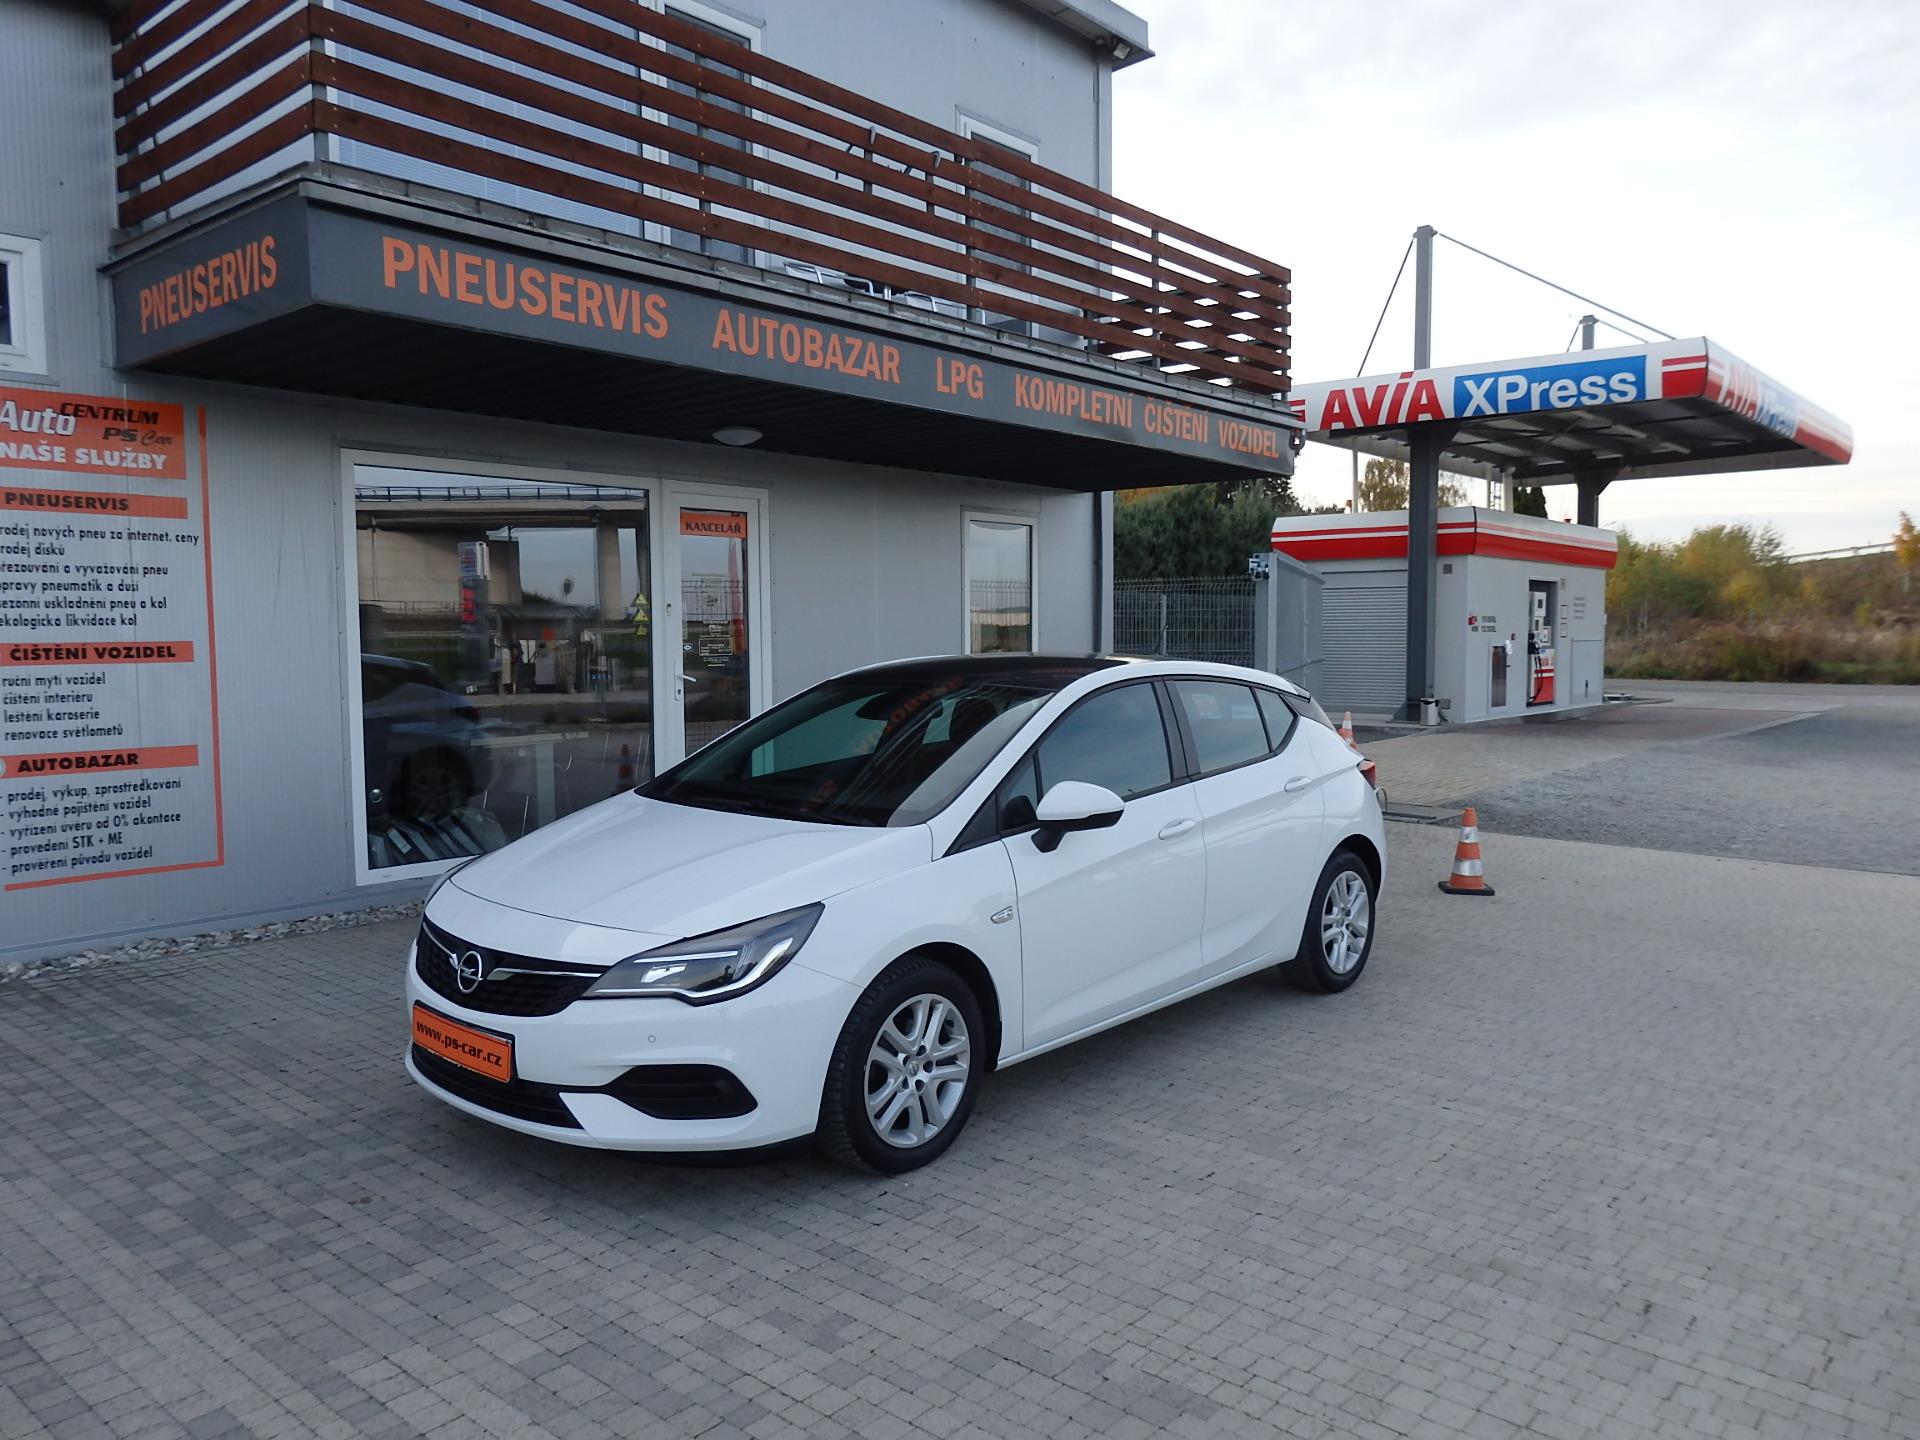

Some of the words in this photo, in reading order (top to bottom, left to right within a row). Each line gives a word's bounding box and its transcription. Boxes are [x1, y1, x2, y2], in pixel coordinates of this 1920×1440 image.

[140, 235, 278, 334] PNEUSERVIS
[382, 236, 669, 339] PNEUSERVIS
[712, 309, 900, 384] AUTOBAZAR
[936, 356, 984, 399] LPG
[1015, 373, 1133, 428] KOMPLETNÍ
[1143, 396, 1209, 443] ČIŠTĚNÍ
[1218, 419, 1279, 459] VOZIDEL
[1463, 371, 1638, 417] XPress
[0, 400, 77, 436] Auto
[60, 402, 159, 425] CENTRUM
[102, 427, 138, 442] PS
[0, 440, 67, 463] NAŠE
[75, 447, 168, 470] SLUŽBY
[5, 492, 129, 511] PNEUSERVIS
[0, 523, 30, 540] rodej
[79, 528, 106, 541] pneu
[110, 530, 123, 540] za
[175, 533, 199, 546] ceny
[0, 541, 31, 558] rodej
[63, 564, 71, 574] a
[143, 566, 169, 578] pneu
[0, 581, 37, 594] pravy
[41, 578, 102, 594] pneumatik
[106, 583, 113, 592] a
[0, 595, 40, 609] ezónní
[110, 600, 137, 613] pneu
[140, 600, 147, 609] a
[150, 595, 167, 609] kol
[65, 613, 116, 627] likvidace
[120, 613, 137, 627] kol
[10, 643, 87, 661] ČIŠTĚNÍ
[94, 646, 176, 660] VOZIDEL
[66, 671, 106, 686] vozidel
[46, 706, 100, 721] karoserie
[5, 730, 59, 741] renovace
[17, 753, 139, 773] AUTOBAZAR
[113, 795, 152, 811] vozidel
[96, 816, 110, 829] od
[133, 812, 182, 825] akontace
[73, 835, 95, 849] STK
[115, 845, 153, 861] vozidel
[416, 1021, 503, 1067] www.ps-car.cz
